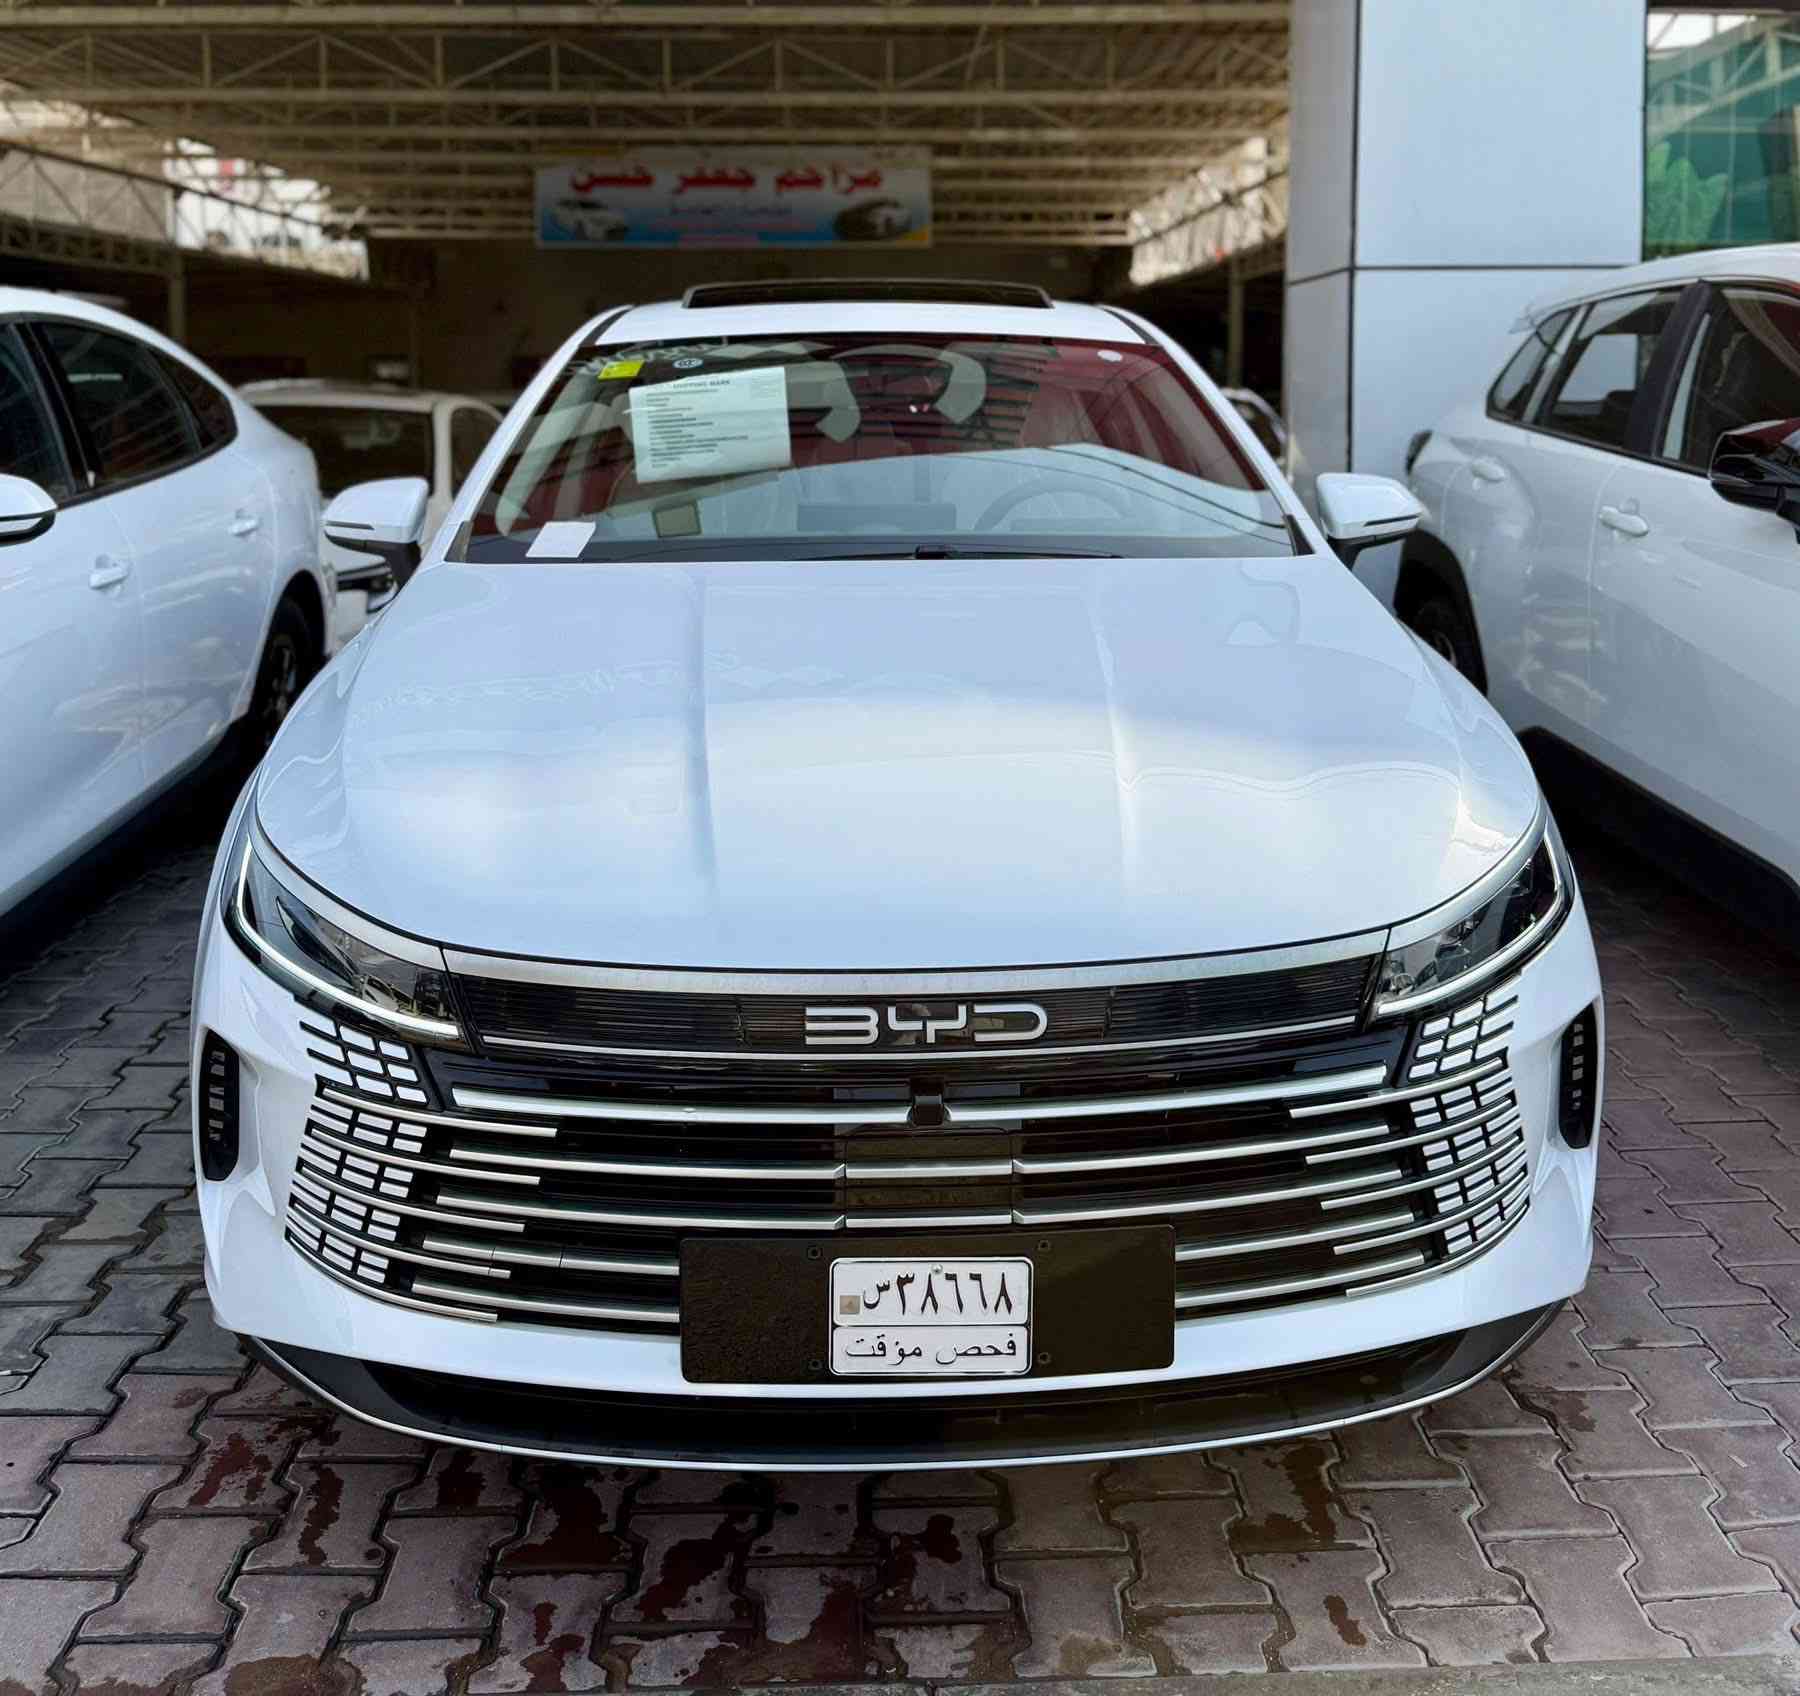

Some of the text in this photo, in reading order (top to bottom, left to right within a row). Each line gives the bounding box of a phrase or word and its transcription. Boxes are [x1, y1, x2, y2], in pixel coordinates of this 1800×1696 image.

[805, 1003, 1048, 1045] BYD
[845, 1332, 1017, 1366] فحص مؤقت
